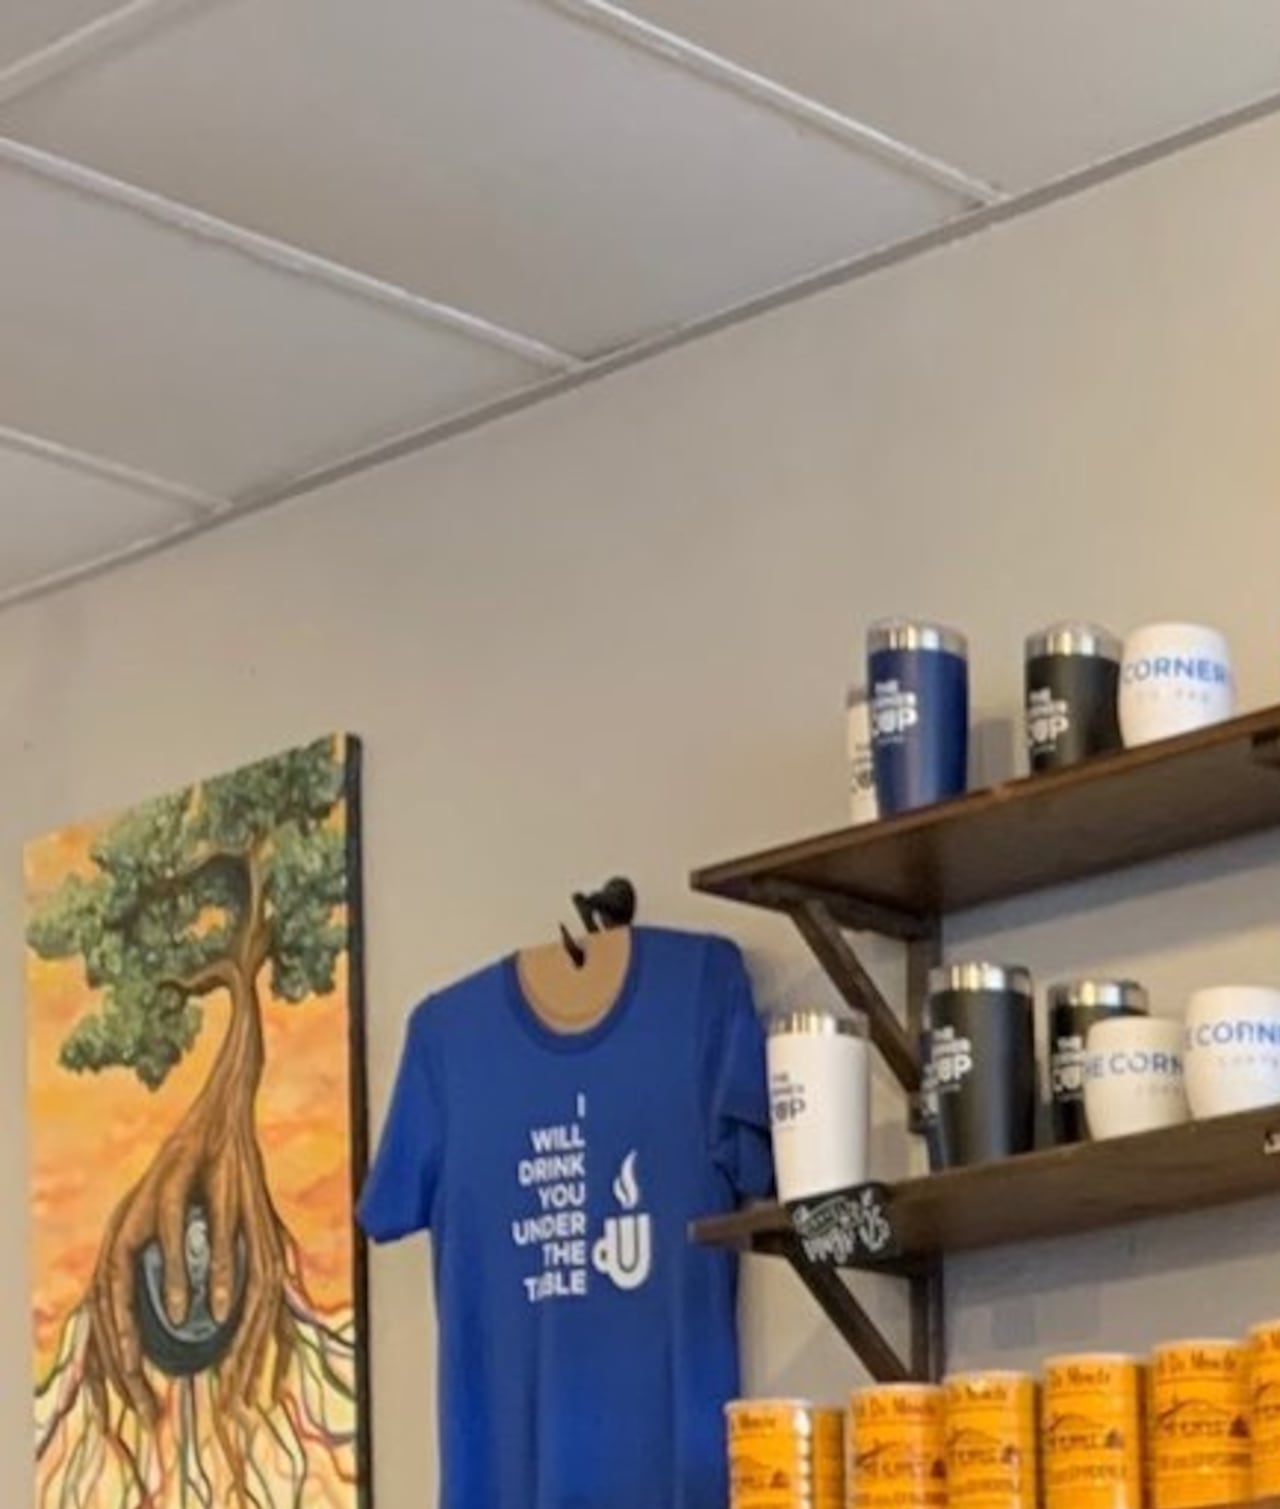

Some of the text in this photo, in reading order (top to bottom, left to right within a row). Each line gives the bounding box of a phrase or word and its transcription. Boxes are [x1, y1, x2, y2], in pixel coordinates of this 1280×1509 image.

[577, 1092, 586, 1118] I
[530, 1123, 586, 1154] WILL
[517, 1151, 586, 1187] DRINK
[537, 1181, 586, 1211] YOU
[511, 1210, 586, 1246] UNDER
[542, 1239, 586, 1267] THE
[523, 1268, 587, 1303] TABLE
